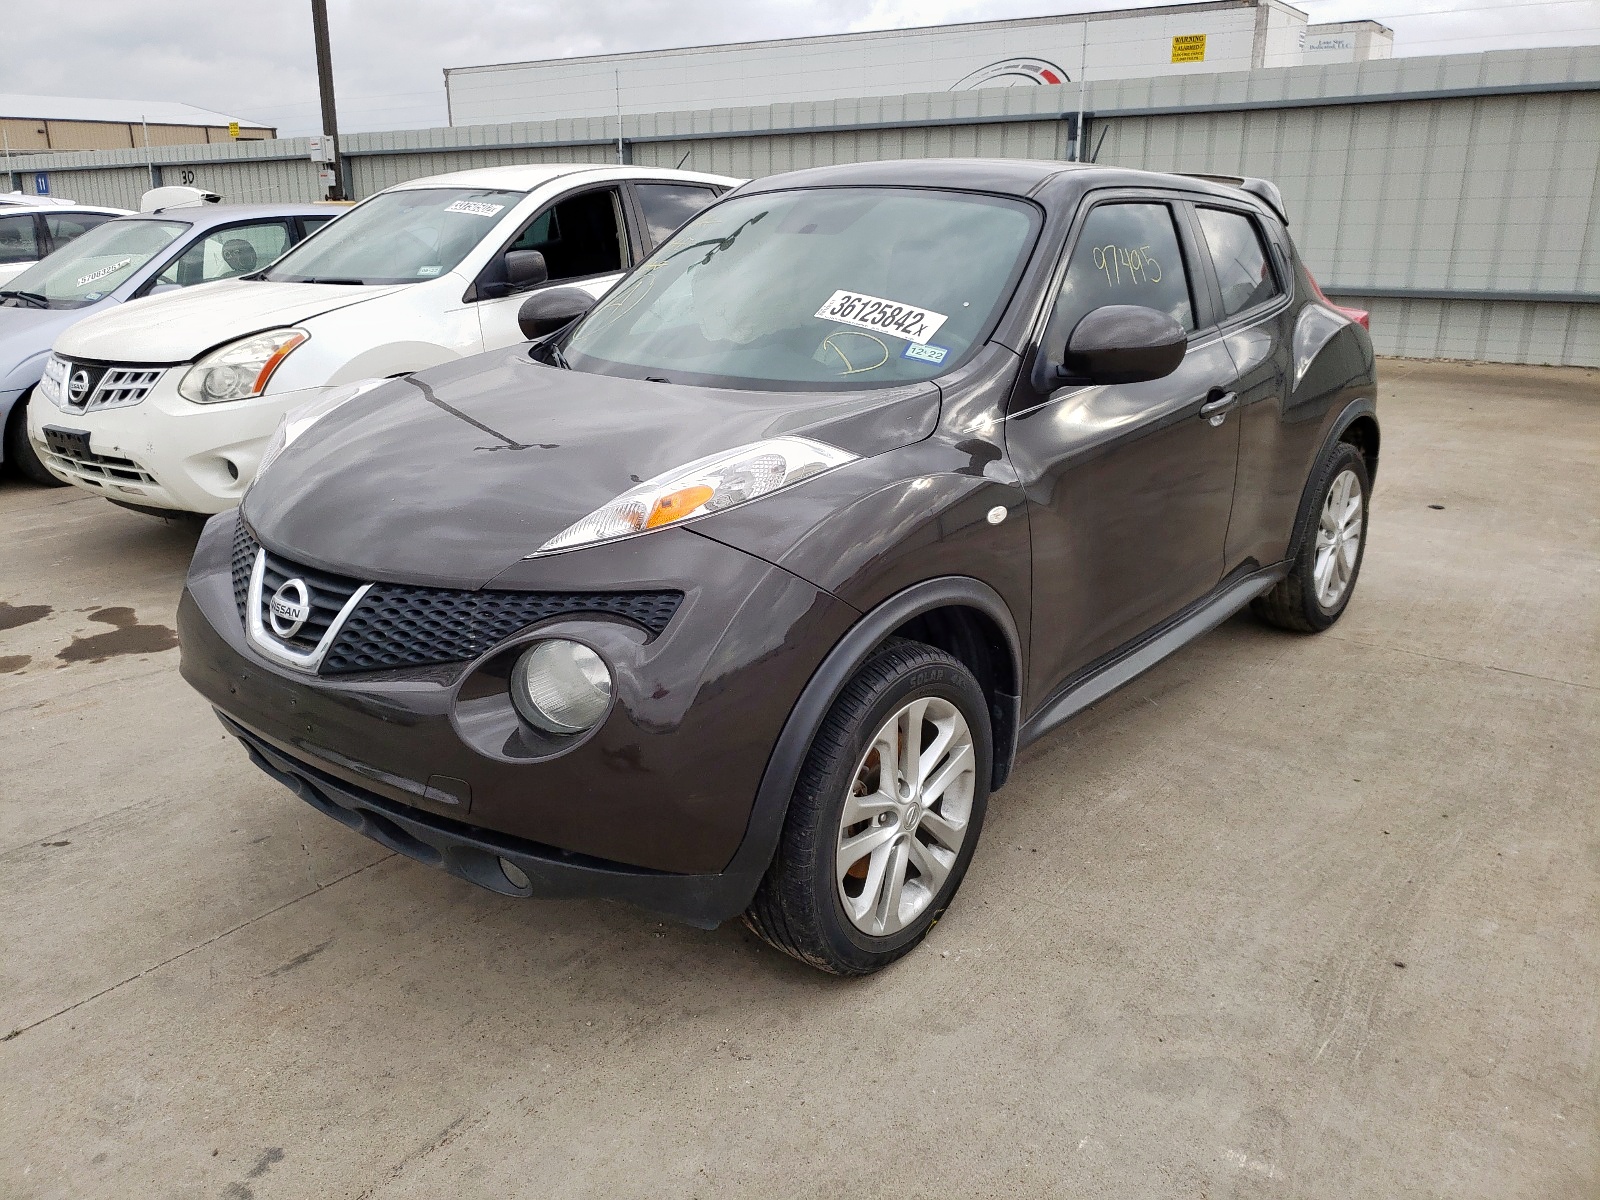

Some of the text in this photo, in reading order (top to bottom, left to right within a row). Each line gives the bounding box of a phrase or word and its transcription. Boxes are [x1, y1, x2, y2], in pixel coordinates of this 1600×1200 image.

[38, 177, 46, 191] 11
[1092, 244, 1163, 287] 97495
[271, 600, 300, 618] NISSAN
